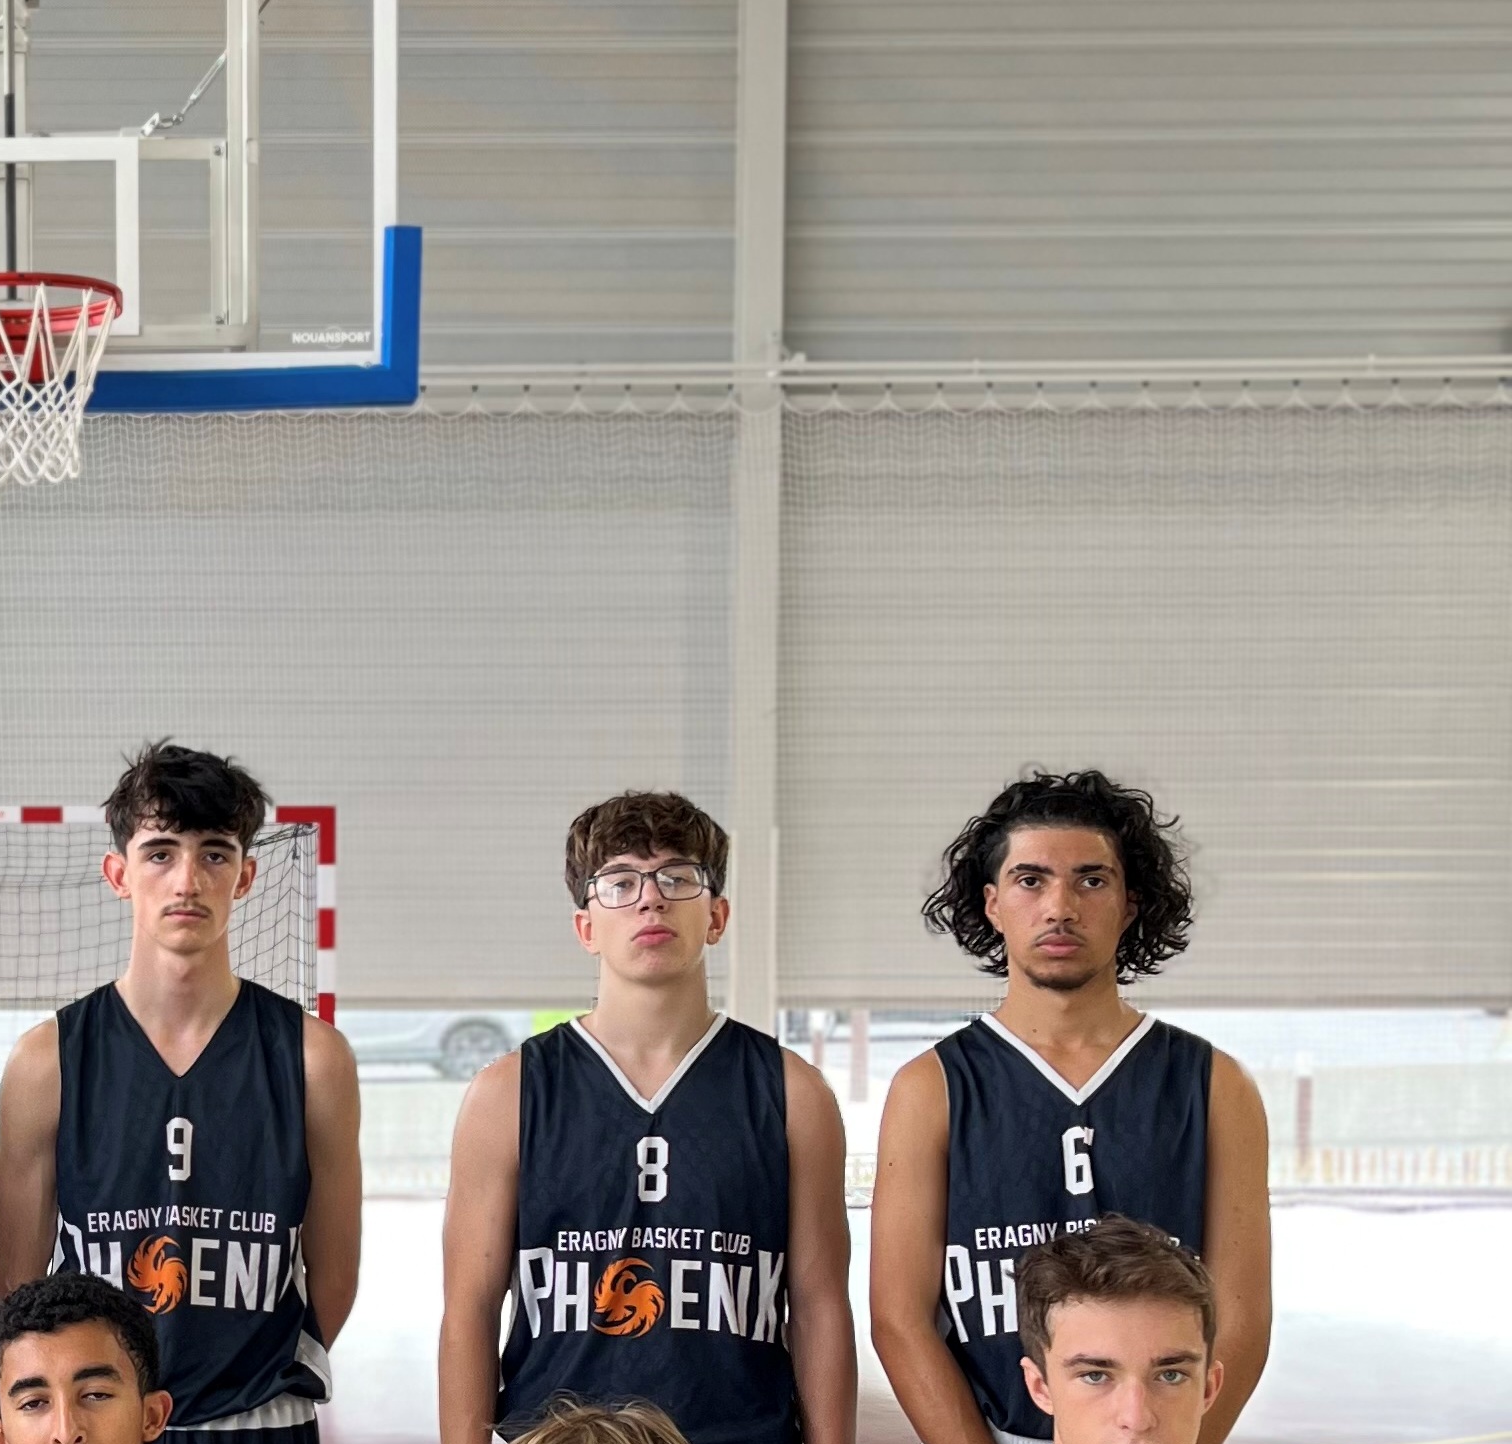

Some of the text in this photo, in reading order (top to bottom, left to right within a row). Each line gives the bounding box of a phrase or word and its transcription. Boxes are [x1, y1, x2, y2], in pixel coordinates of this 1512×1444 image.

[291, 331, 371, 344] NOUANSPORT
[166, 1117, 193, 1181] 9
[1062, 1125, 1094, 1195] 6
[637, 1136, 669, 1202] 8
[88, 1204, 276, 1233] ERAGNY ASKET CLUB
[557, 1227, 751, 1255] ERAGNY BASKET CLUB
[975, 1222, 1057, 1250] ERAGNY
